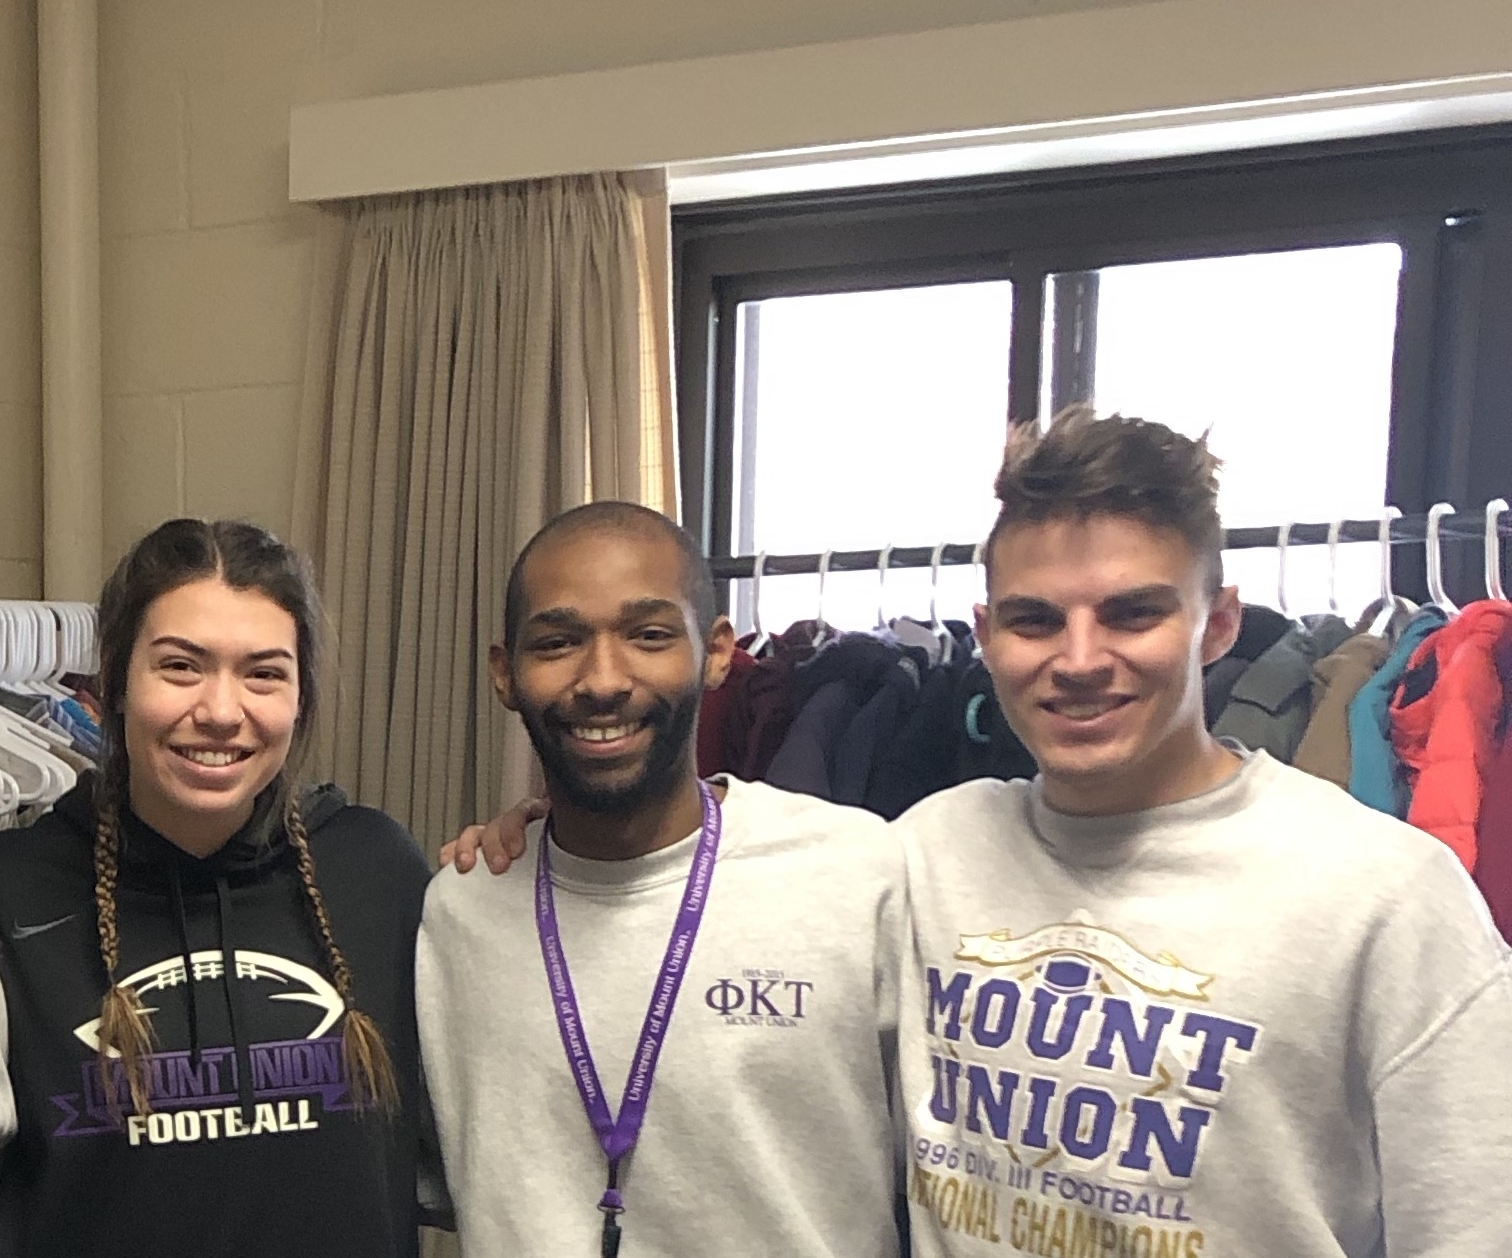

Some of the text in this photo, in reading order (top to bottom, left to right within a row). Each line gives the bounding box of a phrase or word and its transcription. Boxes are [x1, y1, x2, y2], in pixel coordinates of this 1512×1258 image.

[686, 848, 713, 912] University
[704, 832, 716, 847] of
[546, 935, 568, 997] University
[560, 1001, 574, 1014] of
[649, 1018, 663, 1034] of
[652, 974, 676, 1019] Mount
[564, 1016, 584, 1058] Mount
[926, 966, 1259, 1092] MOUNT
[628, 1036, 658, 1102] University
[929, 1054, 1212, 1179] UNION
[1008, 1164, 1031, 1189] III
[1040, 1171, 1192, 1222] FOOTBALL
